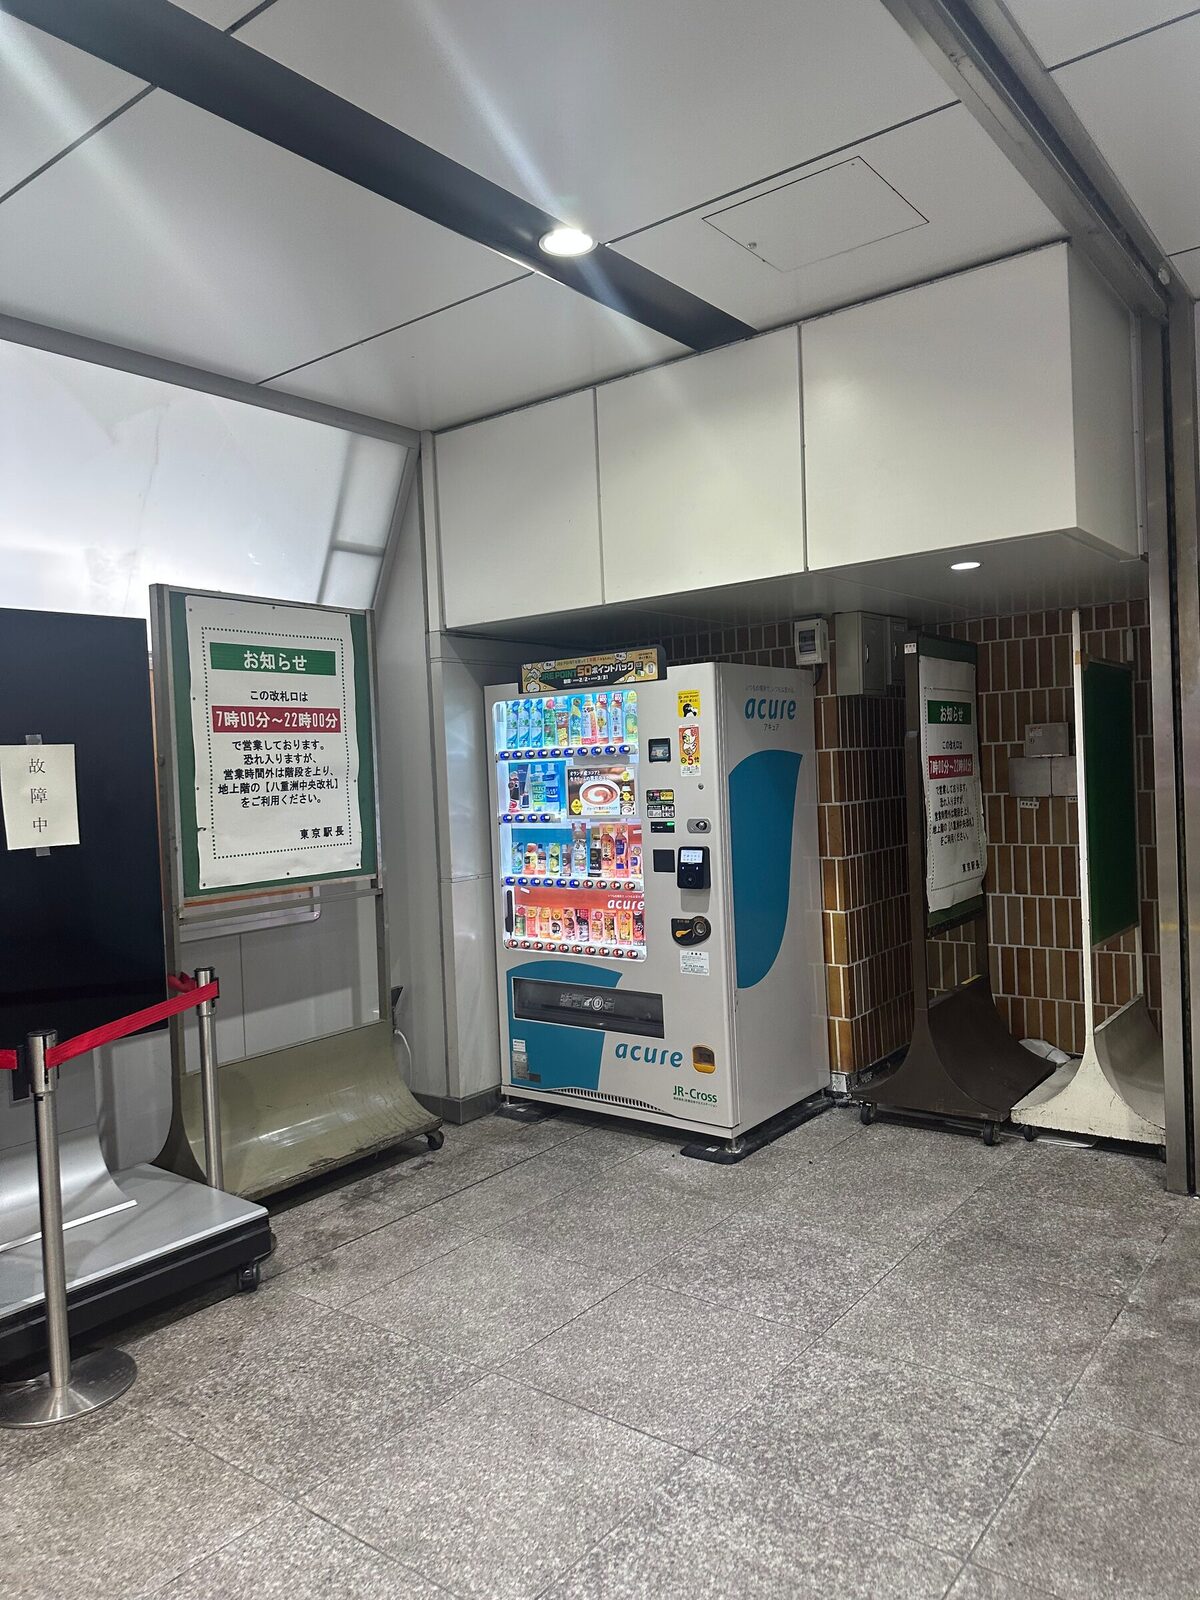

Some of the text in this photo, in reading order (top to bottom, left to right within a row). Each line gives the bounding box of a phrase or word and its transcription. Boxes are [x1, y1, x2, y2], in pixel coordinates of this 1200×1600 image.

[243, 649, 308, 672] お知らせ
[250, 690, 309, 703] この改札口は
[745, 698, 796, 720] acure
[940, 705, 964, 722] お知らせ
[232, 739, 325, 752] で営業しております。
[243, 753, 317, 766] 恐れ入りますが、
[223, 766, 334, 780] 営業時間外は階段を上り、
[29, 758, 48, 832] 故障中
[217, 778, 340, 796] 地上階の【八重洲中央改札】
[240, 795, 322, 808] をご利用ください。
[300, 825, 345, 840] 東京駅長
[607, 899, 645, 910] acure
[615, 1042, 684, 1068] acure
[673, 1085, 718, 1103] JR-Cross
